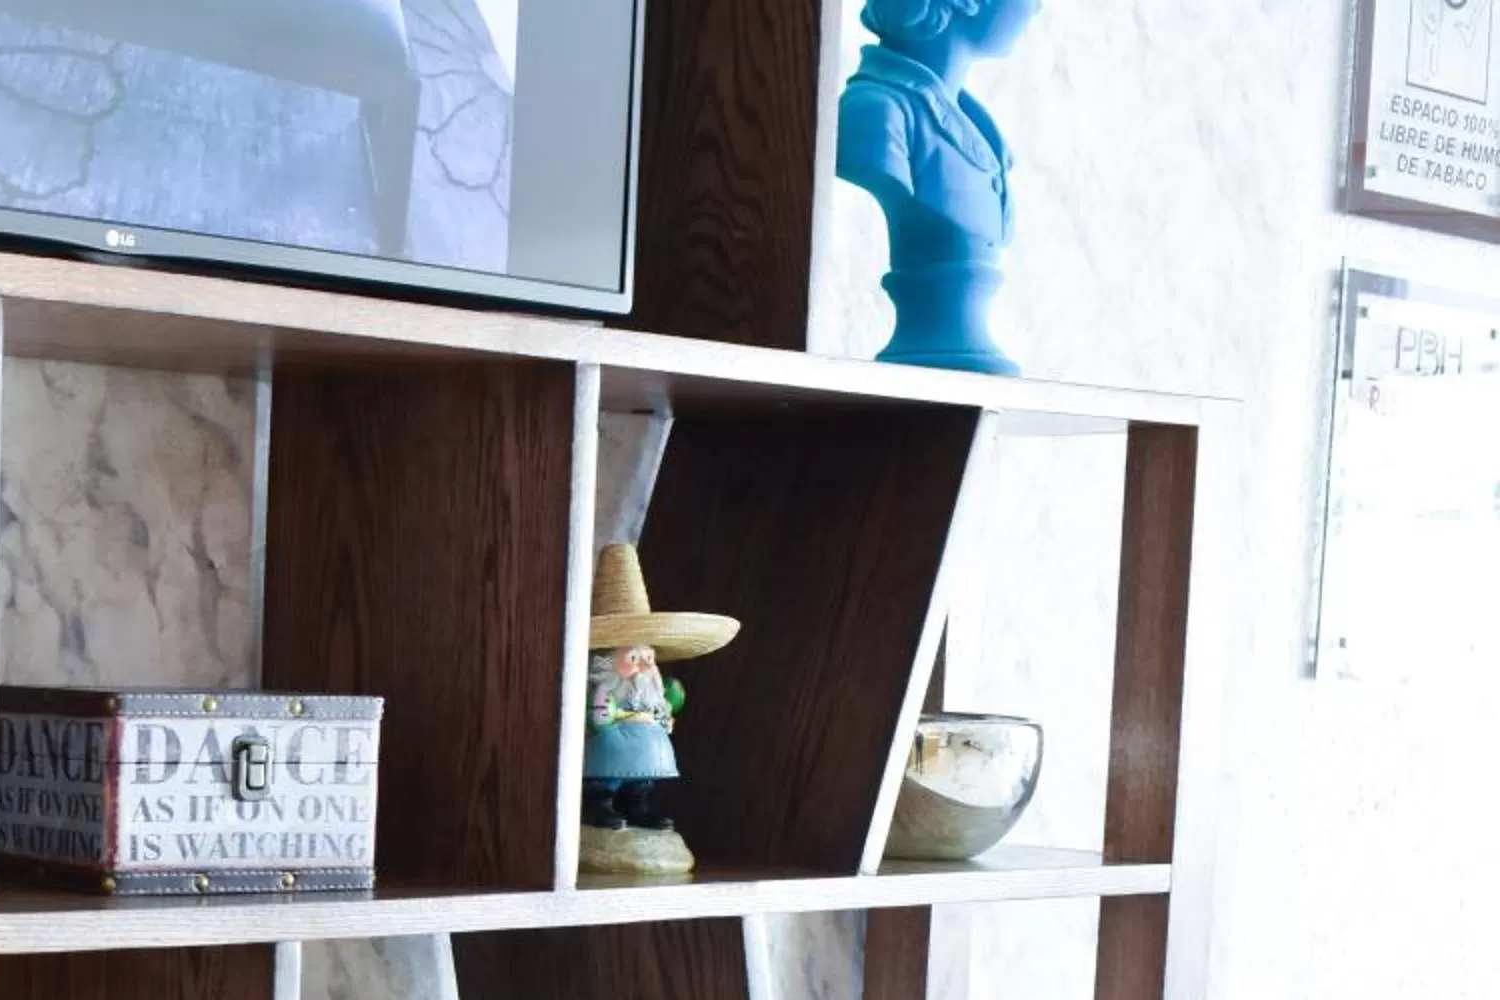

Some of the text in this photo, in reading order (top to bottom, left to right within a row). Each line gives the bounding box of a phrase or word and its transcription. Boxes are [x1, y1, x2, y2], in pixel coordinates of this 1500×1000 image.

[1390, 94, 1459, 128] ESPACIO
[1379, 120, 1430, 150] LIBRE
[1434, 134, 1457, 157] DE
[1396, 152, 1488, 191] DE TABACO
[131, 796, 174, 822] AS
[189, 794, 225, 822] IF
[299, 797, 368, 822] ONE
[129, 832, 366, 862] IS WATCHING
